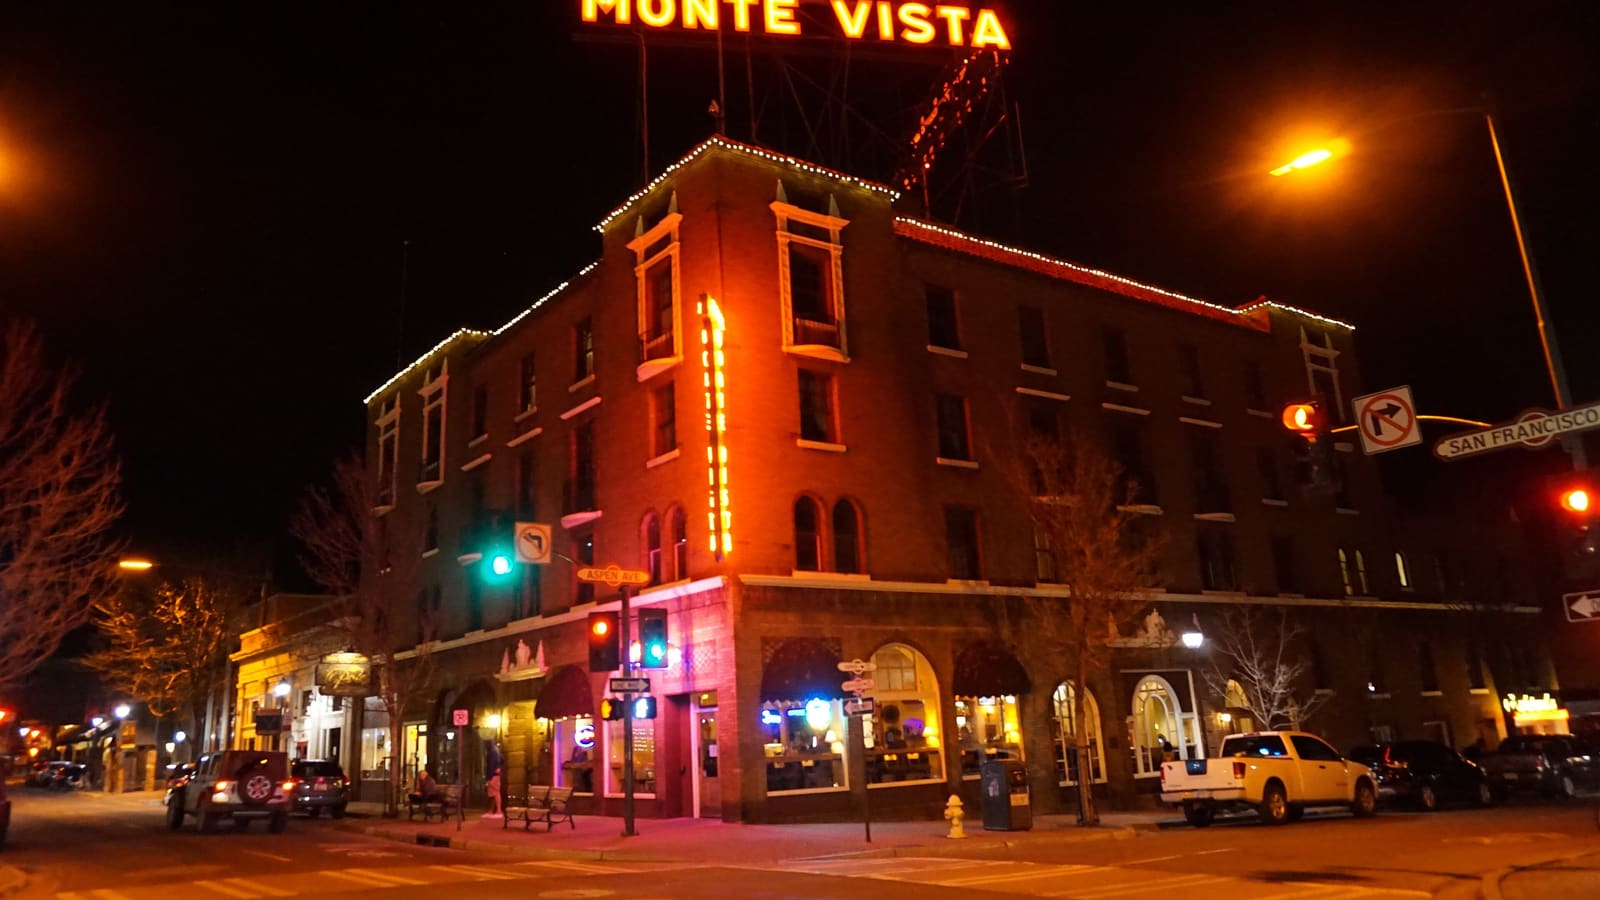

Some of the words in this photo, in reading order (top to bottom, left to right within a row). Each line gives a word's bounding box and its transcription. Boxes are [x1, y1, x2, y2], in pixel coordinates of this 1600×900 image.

[581, 0, 801, 34] MONTE
[830, 0, 1012, 50] VISTA
[1450, 434, 1486, 455] SAN
[1491, 408, 1599, 445] FRANCISCO
[586, 570, 618, 580] ASPEN
[622, 571, 641, 581] AVE
